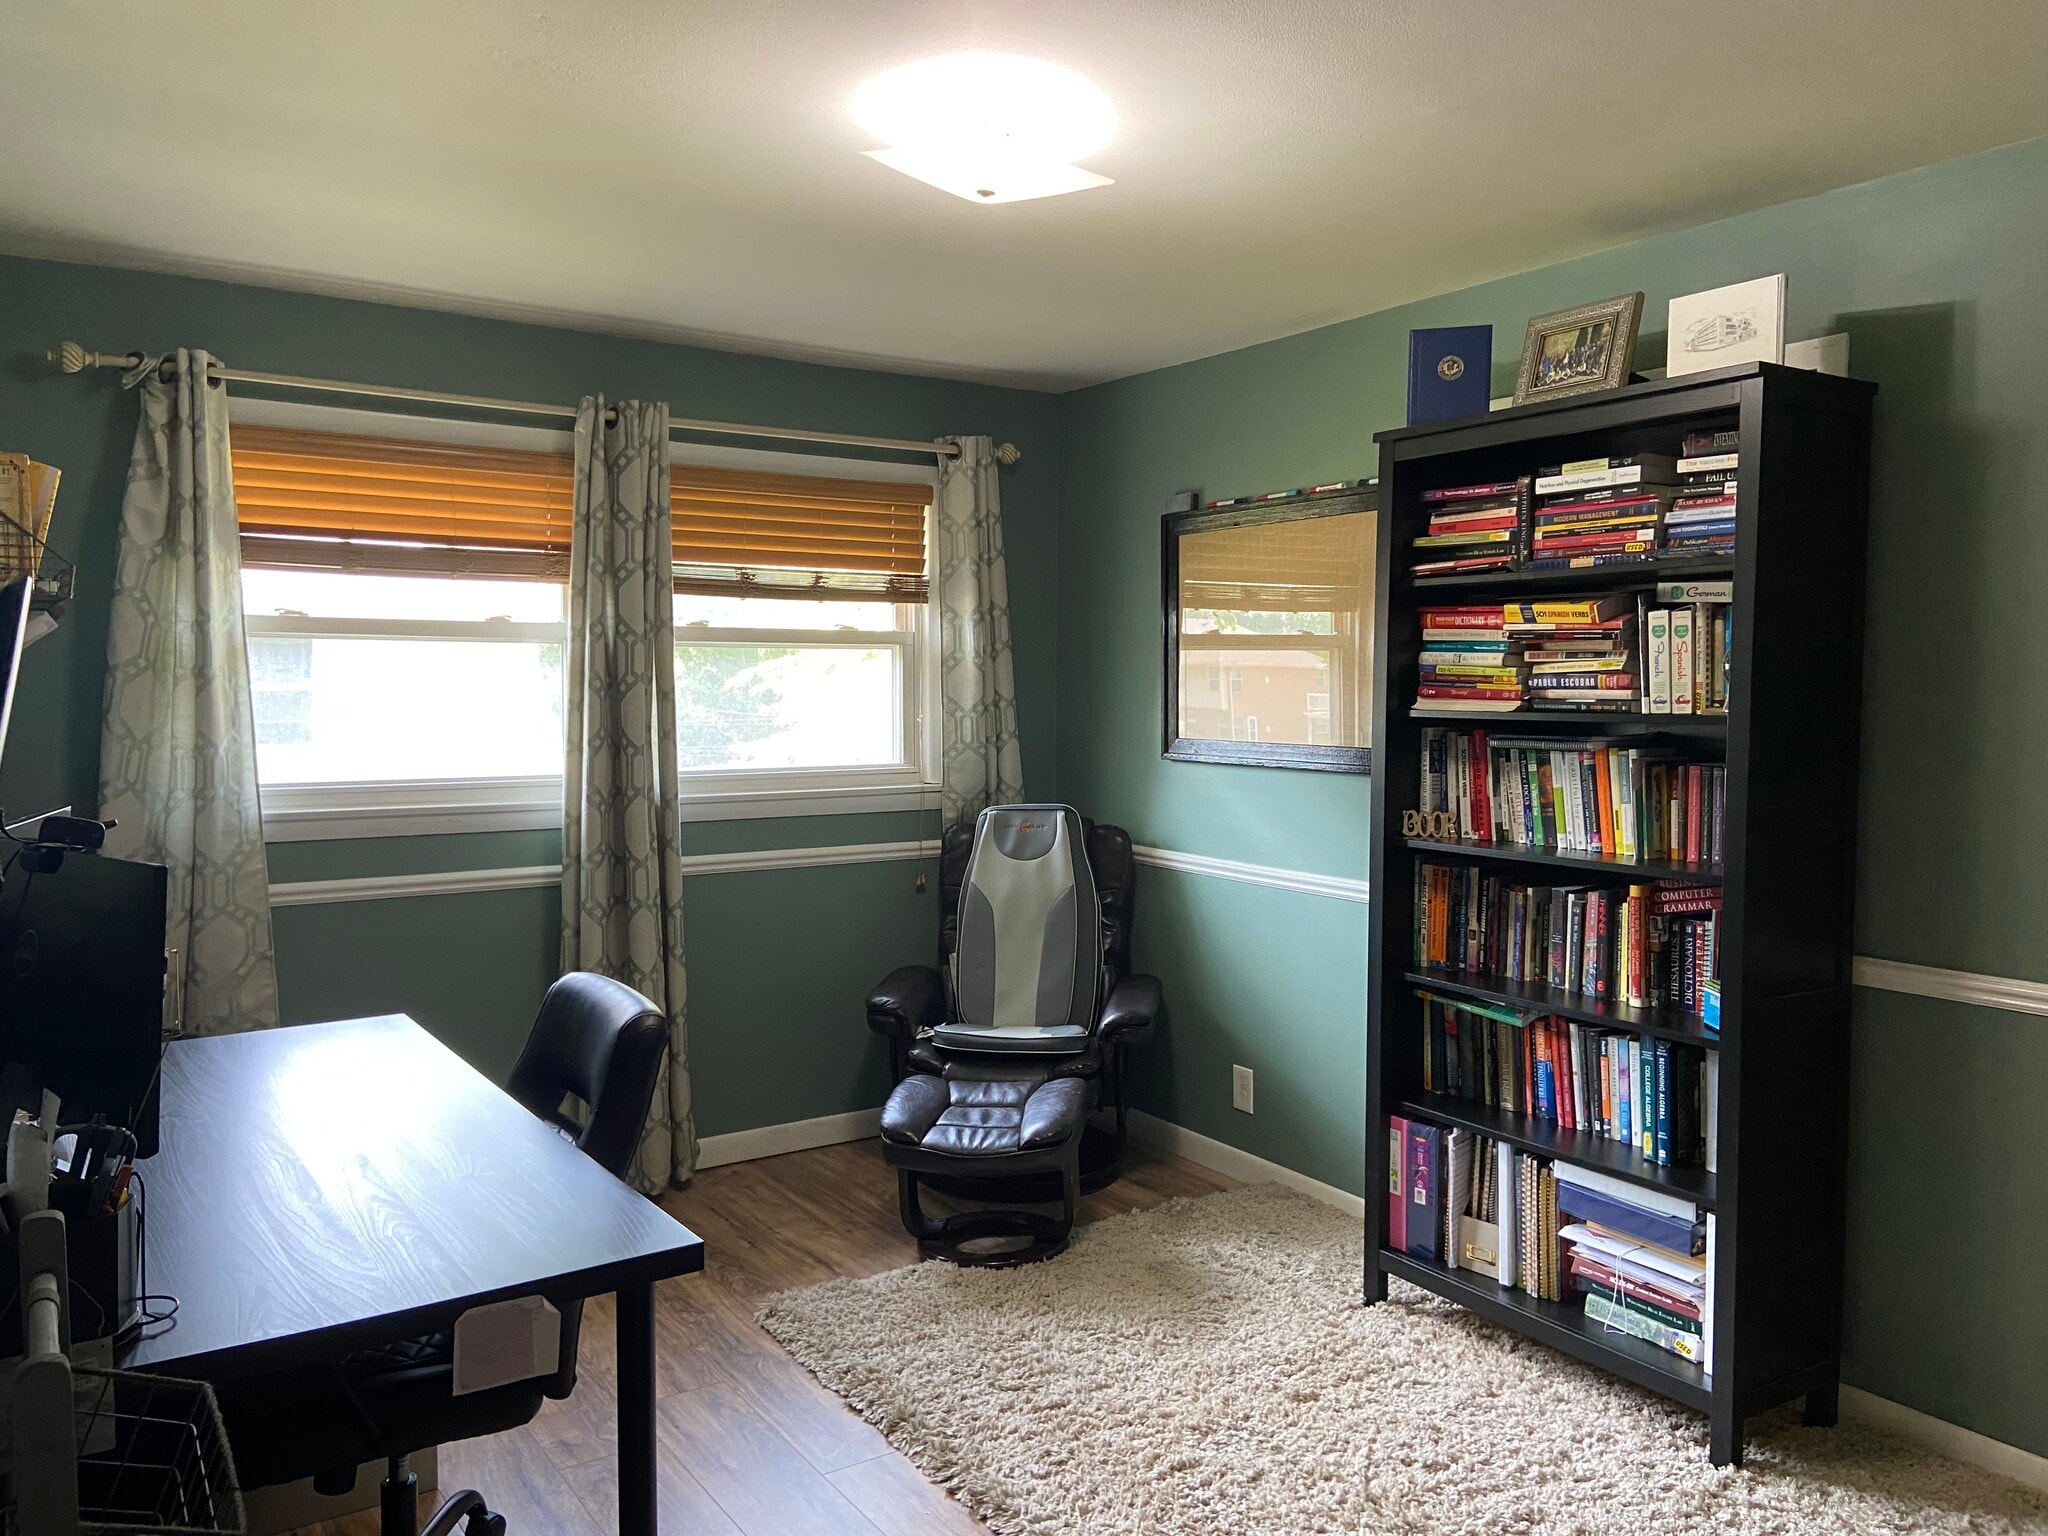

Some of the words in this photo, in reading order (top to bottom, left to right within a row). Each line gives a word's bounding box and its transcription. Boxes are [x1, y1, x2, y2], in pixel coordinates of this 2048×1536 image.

[1705, 473, 1725, 483] FAIL
[1553, 514, 1578, 523] MODERN
[1578, 510, 1619, 520] MANAGEMENT
[1686, 586, 1727, 597] German
[1454, 616, 1485, 625] DICTIONARY
[1654, 641, 1665, 678] French
[1673, 640, 1688, 681] Spanish
[1533, 678, 1557, 687] PABLO
[1561, 678, 1596, 687] ESCOBAR
[1570, 757, 1580, 800] beautiful
[1477, 784, 1483, 795] TO
[1515, 792, 1523, 826] BITCHES
[1573, 803, 1581, 820] boy
[1654, 888, 1714, 902] COMPUTER
[1655, 900, 1713, 913] GRAMMAR
[1670, 937, 1679, 1001] THESAURUS
[1684, 936, 1693, 1005] DICTIONARY
[1695, 939, 1704, 998] SPELLER
[1631, 1053, 1639, 1074] blink
[1536, 1063, 1546, 1098] IRRATIONAL
[1675, 1340, 1692, 1355] USED
